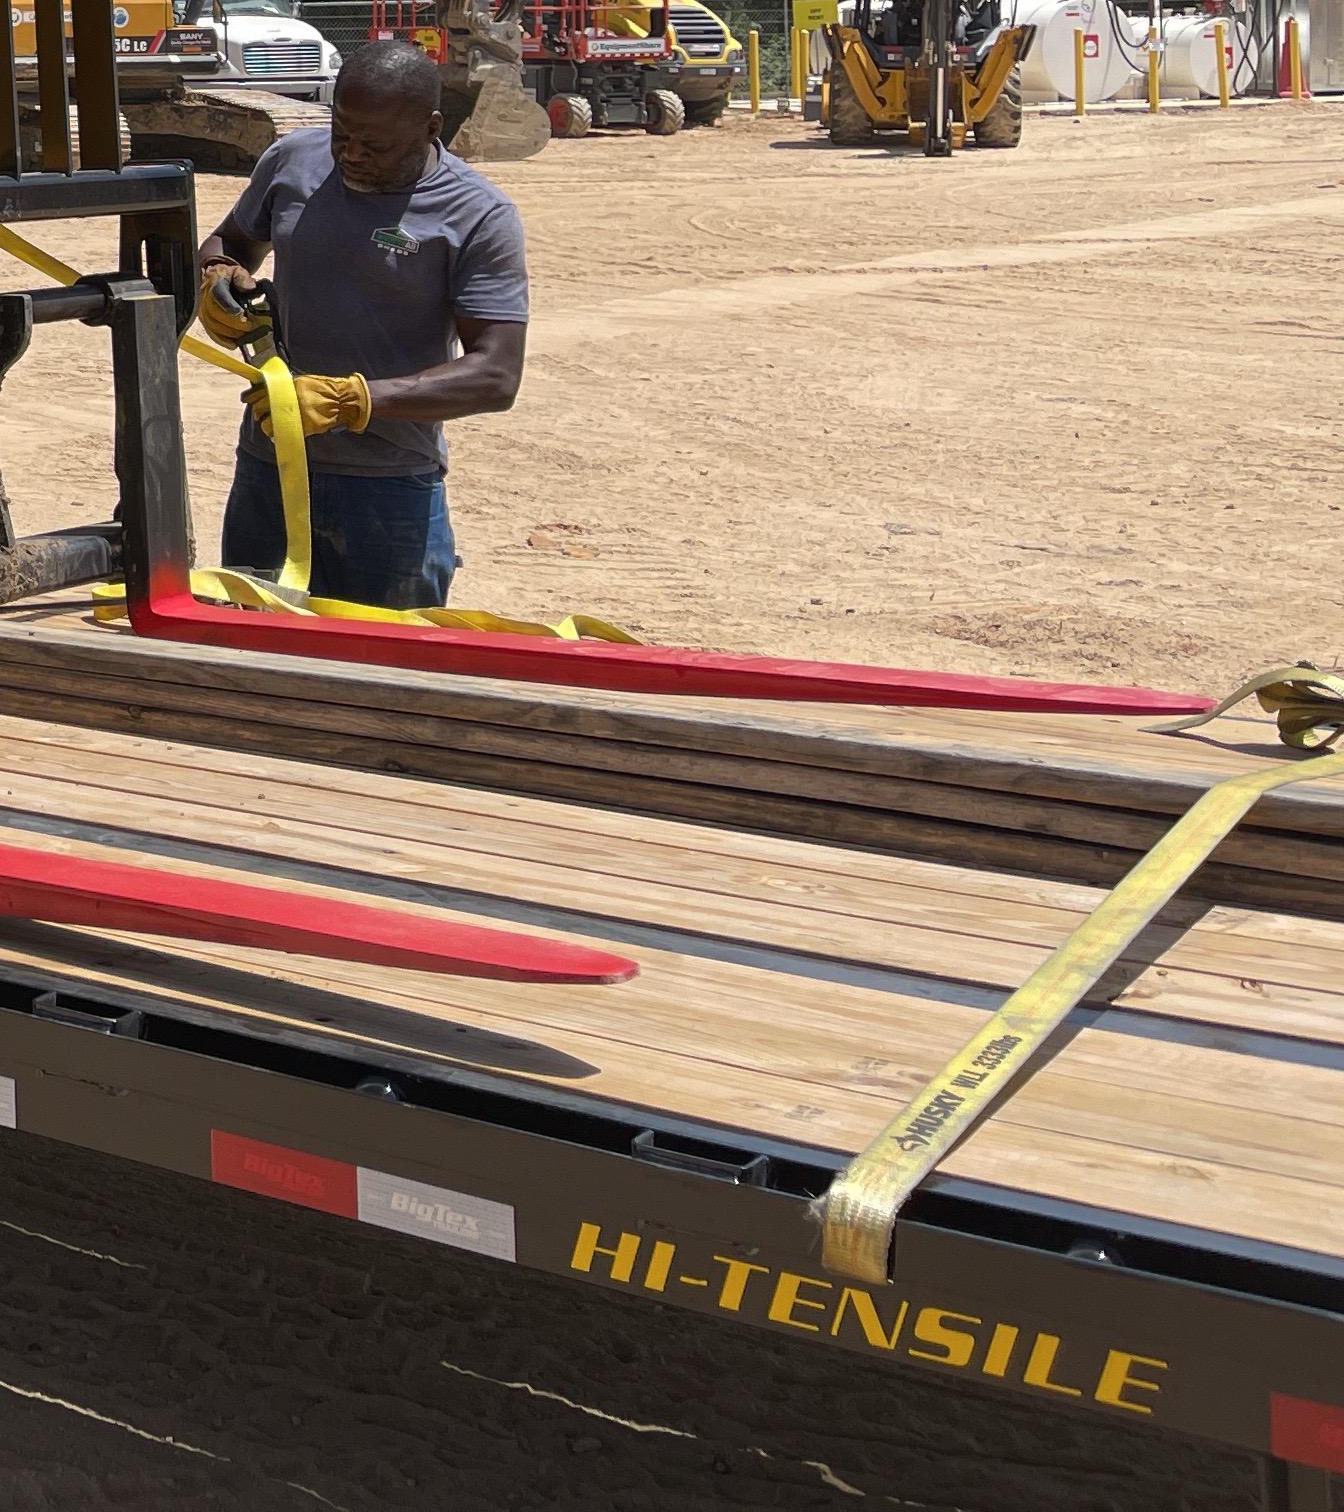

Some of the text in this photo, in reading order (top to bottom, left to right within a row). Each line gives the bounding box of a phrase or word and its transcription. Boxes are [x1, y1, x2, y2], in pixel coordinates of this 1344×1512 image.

[179, 32, 204, 41] SANY
[905, 1088, 966, 1138] HUSKY
[950, 1068, 990, 1090] WLL
[390, 1191, 481, 1231] BigTex
[569, 1221, 1169, 1416] HI-TENSILE
